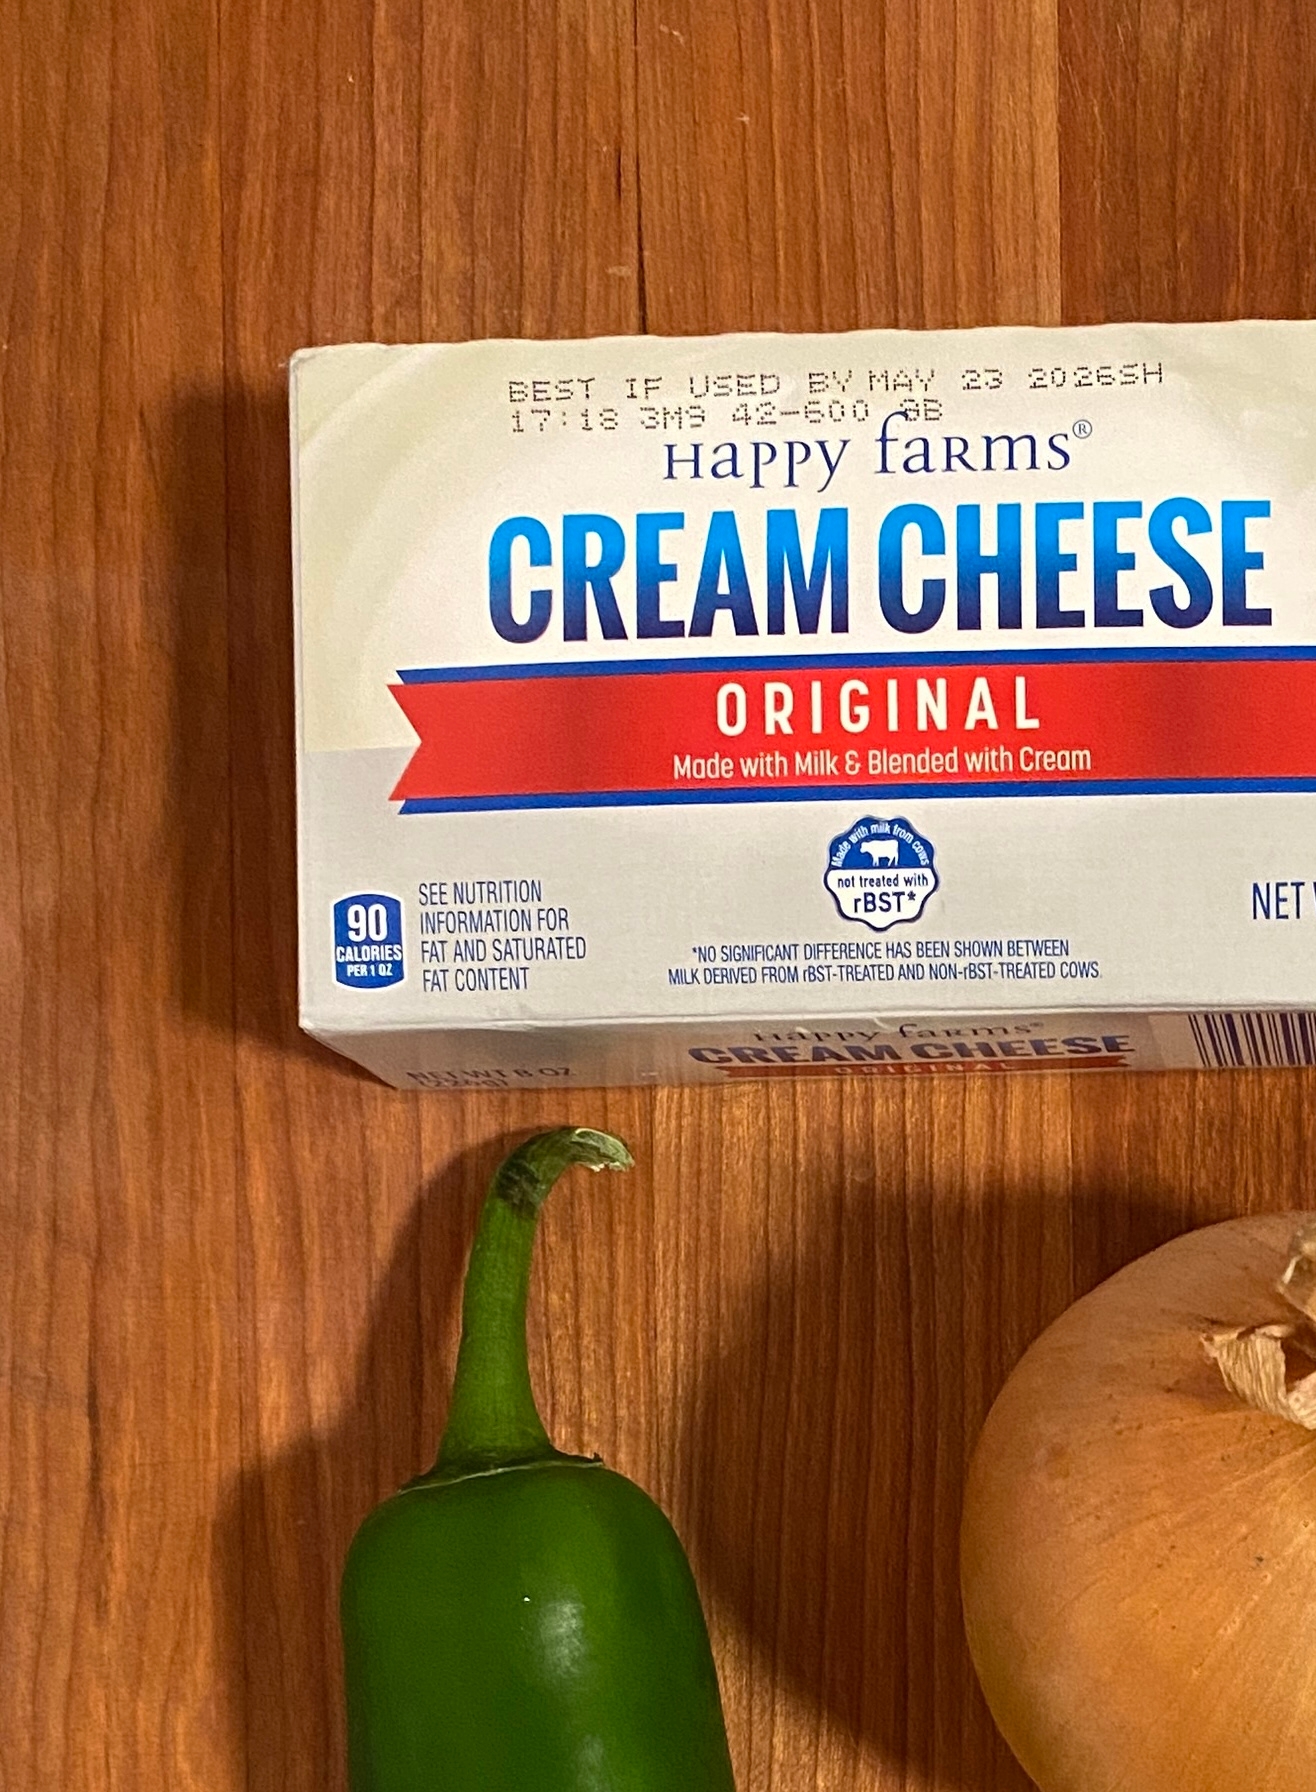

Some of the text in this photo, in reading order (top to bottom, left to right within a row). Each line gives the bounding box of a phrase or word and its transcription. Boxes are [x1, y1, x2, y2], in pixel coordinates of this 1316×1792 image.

[509, 362, 1163, 402] BEST IF USED BY MAY 23 2026SH
[512, 408, 619, 433] 17:18
[732, 399, 868, 426] 42-600
[663, 438, 851, 491] Happy
[488, 496, 1273, 644] CREAM CHEESE
[716, 675, 1040, 737] ORIGINAL
[673, 746, 1092, 781] Made with Milk & Blended with Cream
[830, 822, 930, 867] Made with milk from cows
[419, 879, 542, 906] SEE NUTRITION
[837, 872, 929, 888] not treated with
[1252, 882, 1304, 921] NET
[347, 903, 387, 943] 90
[420, 908, 569, 935] INFORMATION FOR
[336, 944, 402, 963] CALORIES
[421, 936, 587, 963] FAT AND SATURATED
[721, 944, 799, 962] SIGNIFICANT
[804, 942, 882, 960] DIFFERENCE
[886, 941, 912, 958] HAS
[916, 940, 950, 958] BEEN
[954, 940, 1003, 957] SHOWN
[1008, 939, 1069, 957] BETWEEN
[346, 963, 393, 977] PER 1 OZ
[422, 966, 530, 992] FAT CONTENT
[668, 968, 700, 985] MILK
[704, 966, 757, 984] DERIVED
[762, 965, 799, 983] FROM
[803, 964, 894, 982] rBST-TREATED
[898, 963, 925, 981] AND
[688, 1035, 1136, 1064] CREAM CHEESE
[835, 1062, 1015, 1074] ORIGINAL
